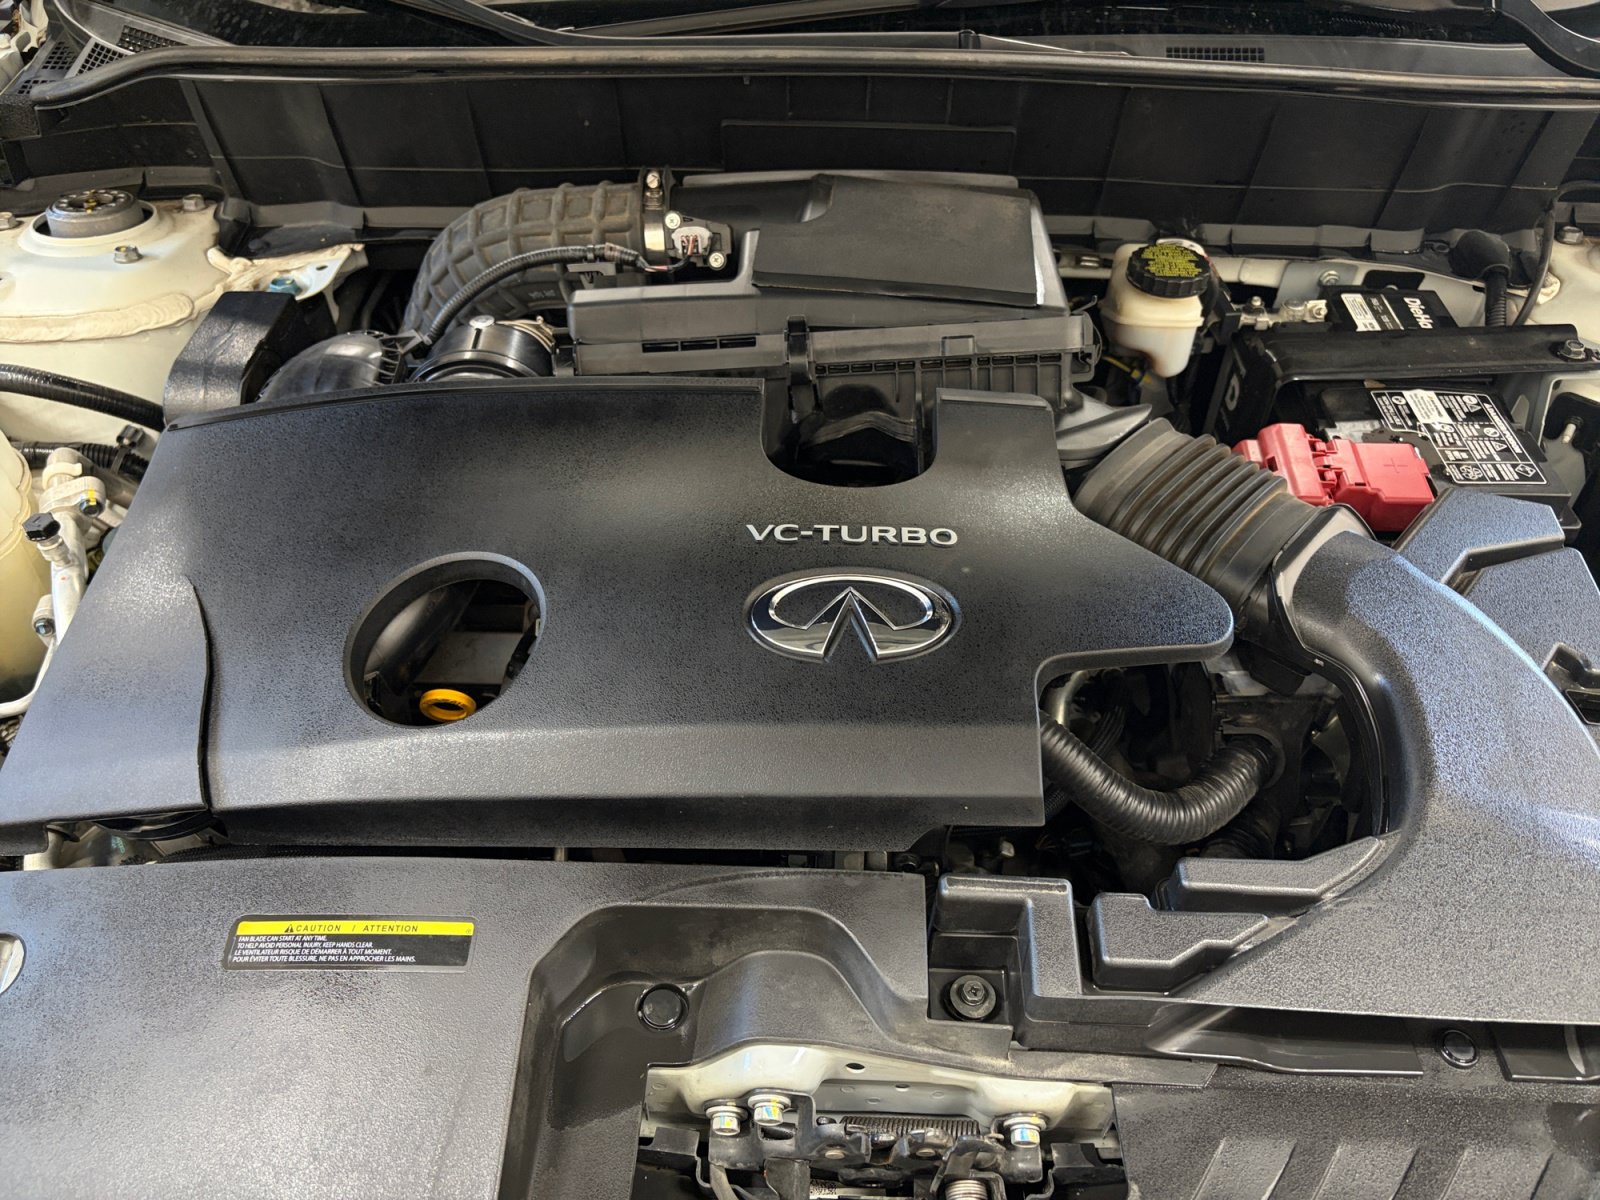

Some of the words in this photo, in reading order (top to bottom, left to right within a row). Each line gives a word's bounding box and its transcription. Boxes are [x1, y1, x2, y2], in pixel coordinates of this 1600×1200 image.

[1403, 297, 1433, 329] DieHa
[746, 523, 958, 547] VC-TURBO
[296, 924, 341, 932] CAUTION
